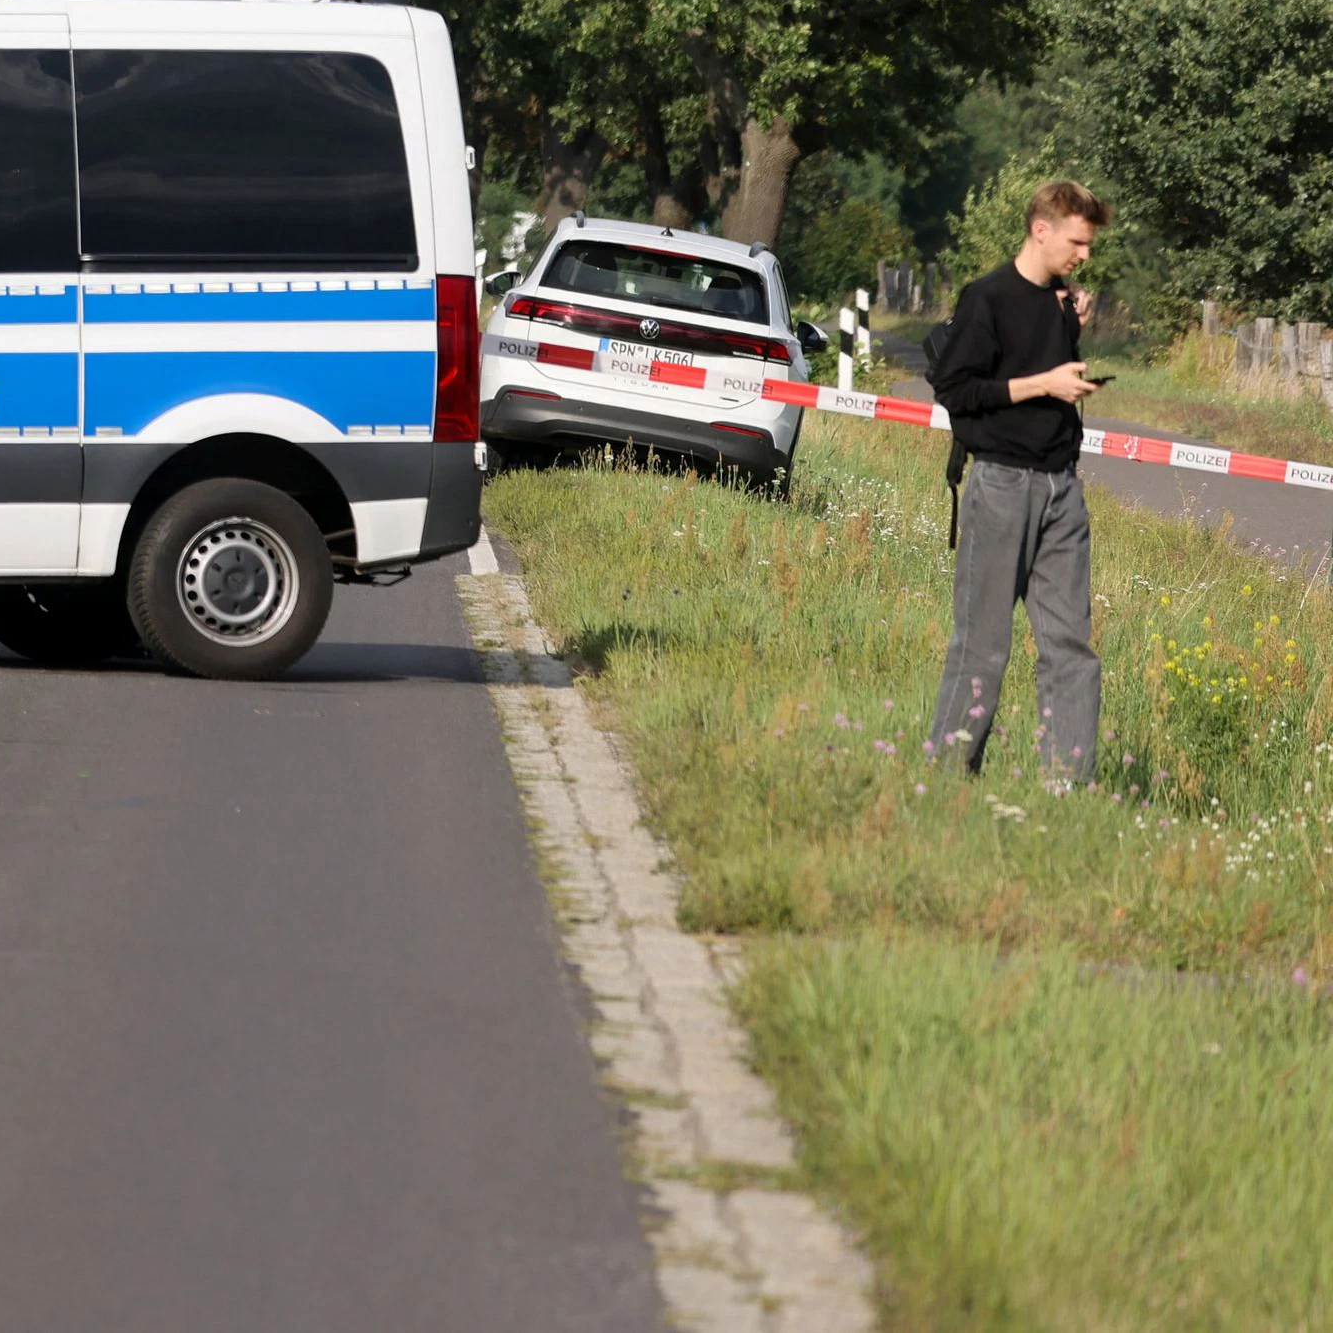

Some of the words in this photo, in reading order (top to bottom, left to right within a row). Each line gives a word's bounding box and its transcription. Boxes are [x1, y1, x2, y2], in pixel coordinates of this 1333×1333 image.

[499, 341, 549, 358] POLIZEI
[610, 341, 637, 357] SPN
[611, 360, 661, 378] POLIZEI
[724, 377, 773, 395] POLIZEI
[1176, 450, 1227, 468] POLIZEI
